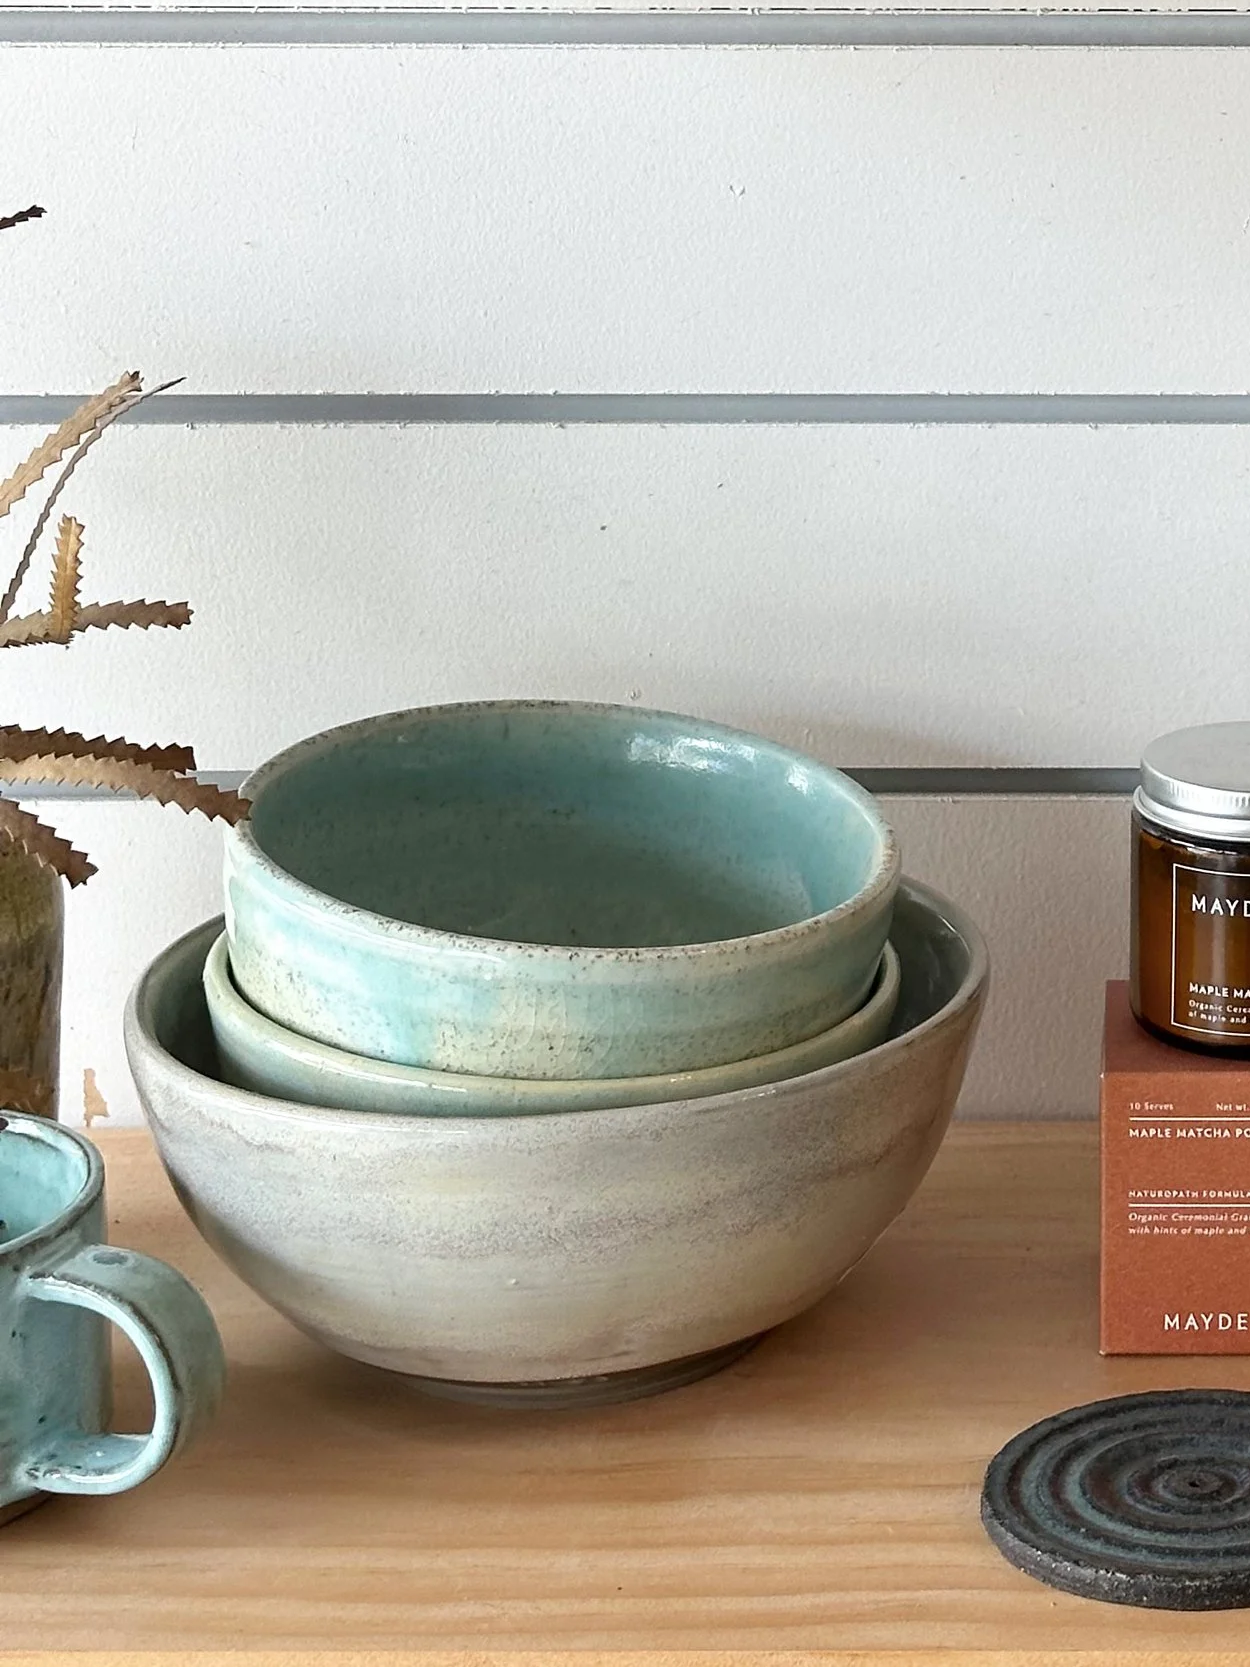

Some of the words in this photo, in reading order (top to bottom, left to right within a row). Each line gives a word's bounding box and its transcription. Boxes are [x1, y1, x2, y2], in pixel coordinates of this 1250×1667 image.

[1189, 982, 1229, 998] MAPLE
[1188, 999, 1223, 1012] Organic
[1230, 1015, 1246, 1024] and
[1144, 1102, 1174, 1111] Serves
[1216, 1103, 1232, 1111] Net
[1129, 1128, 1171, 1138] MAPLE
[1176, 1128, 1231, 1138] MATCHA
[1129, 1190, 1199, 1198] NATUROPATH
[1128, 1213, 1167, 1223] Organic
[1172, 1213, 1228, 1222] Ceremonial
[1128, 1226, 1150, 1235] with
[1181, 1226, 1191, 1235] of
[1194, 1226, 1224, 1237] maple
[1227, 1226, 1246, 1235] and
[1163, 1313, 1248, 1331] MAYDE
